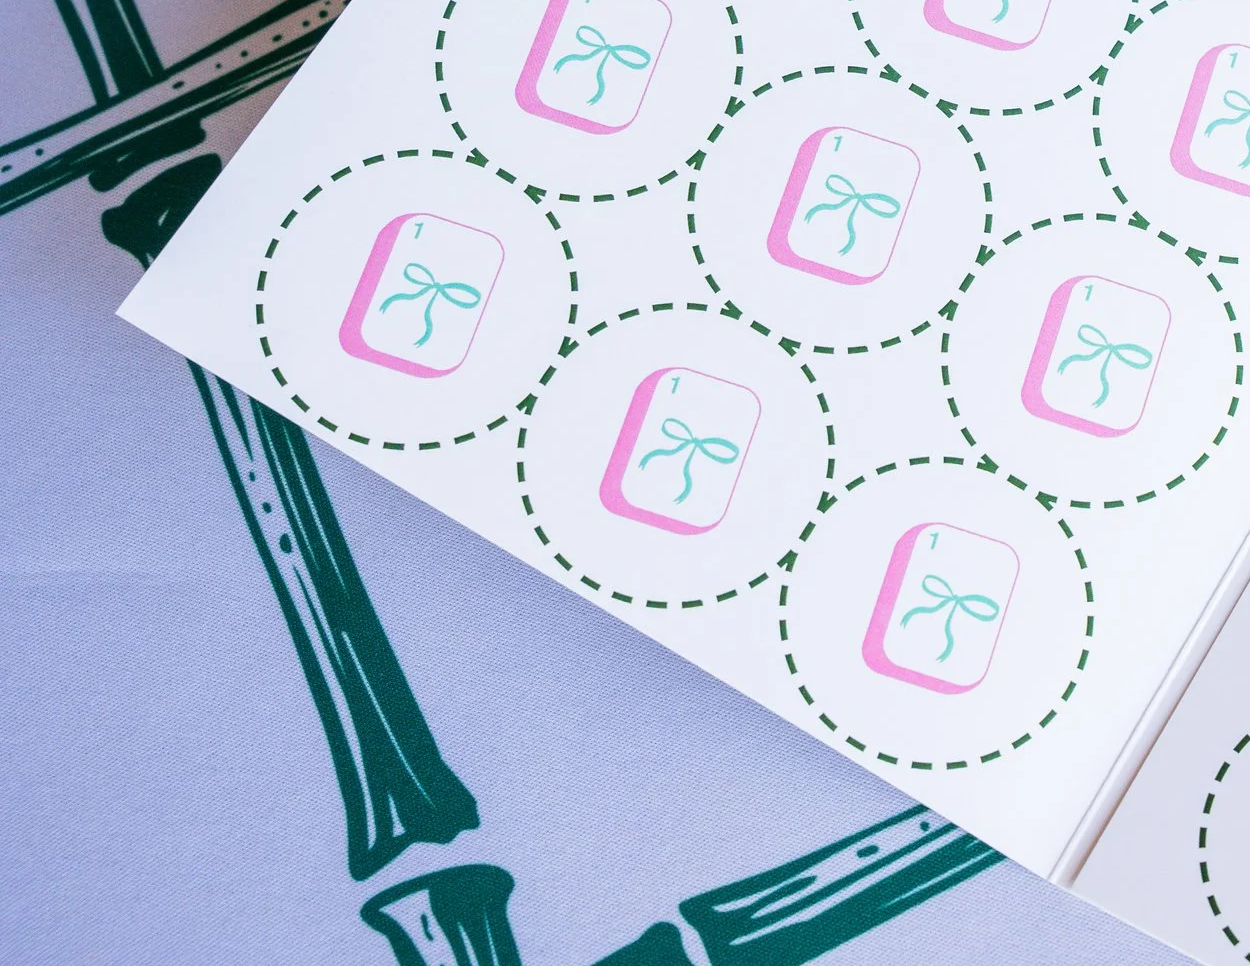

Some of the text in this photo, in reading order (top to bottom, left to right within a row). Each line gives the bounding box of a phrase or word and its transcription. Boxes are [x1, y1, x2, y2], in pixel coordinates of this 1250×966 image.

[1229, 52, 1238, 68] 1
[834, 136, 843, 152] 1
[414, 222, 424, 239] 1
[1084, 284, 1093, 301] 1
[671, 376, 680, 394] 1
[929, 532, 939, 550] 1
